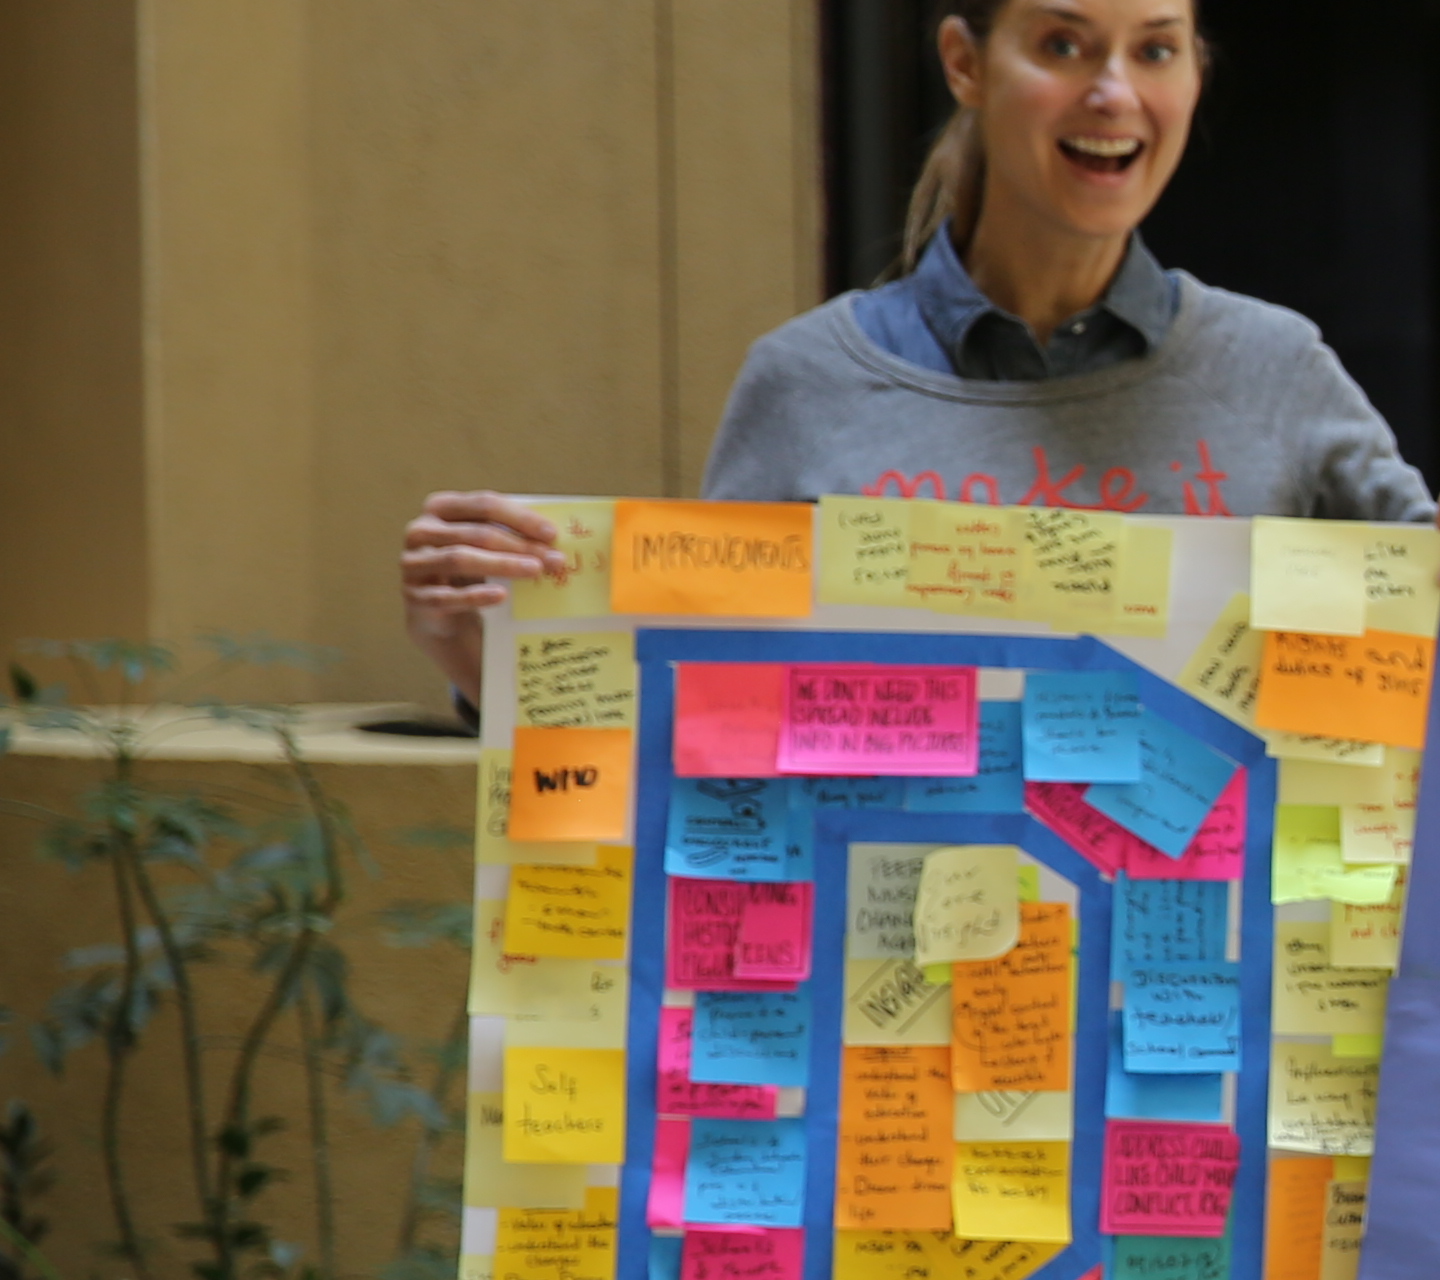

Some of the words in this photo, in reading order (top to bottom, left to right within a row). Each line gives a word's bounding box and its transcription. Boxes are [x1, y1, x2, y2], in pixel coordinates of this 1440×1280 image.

[861, 445, 1149, 514] make
[1168, 439, 1234, 516] it
[632, 533, 811, 573] IMPROVEMENTS
